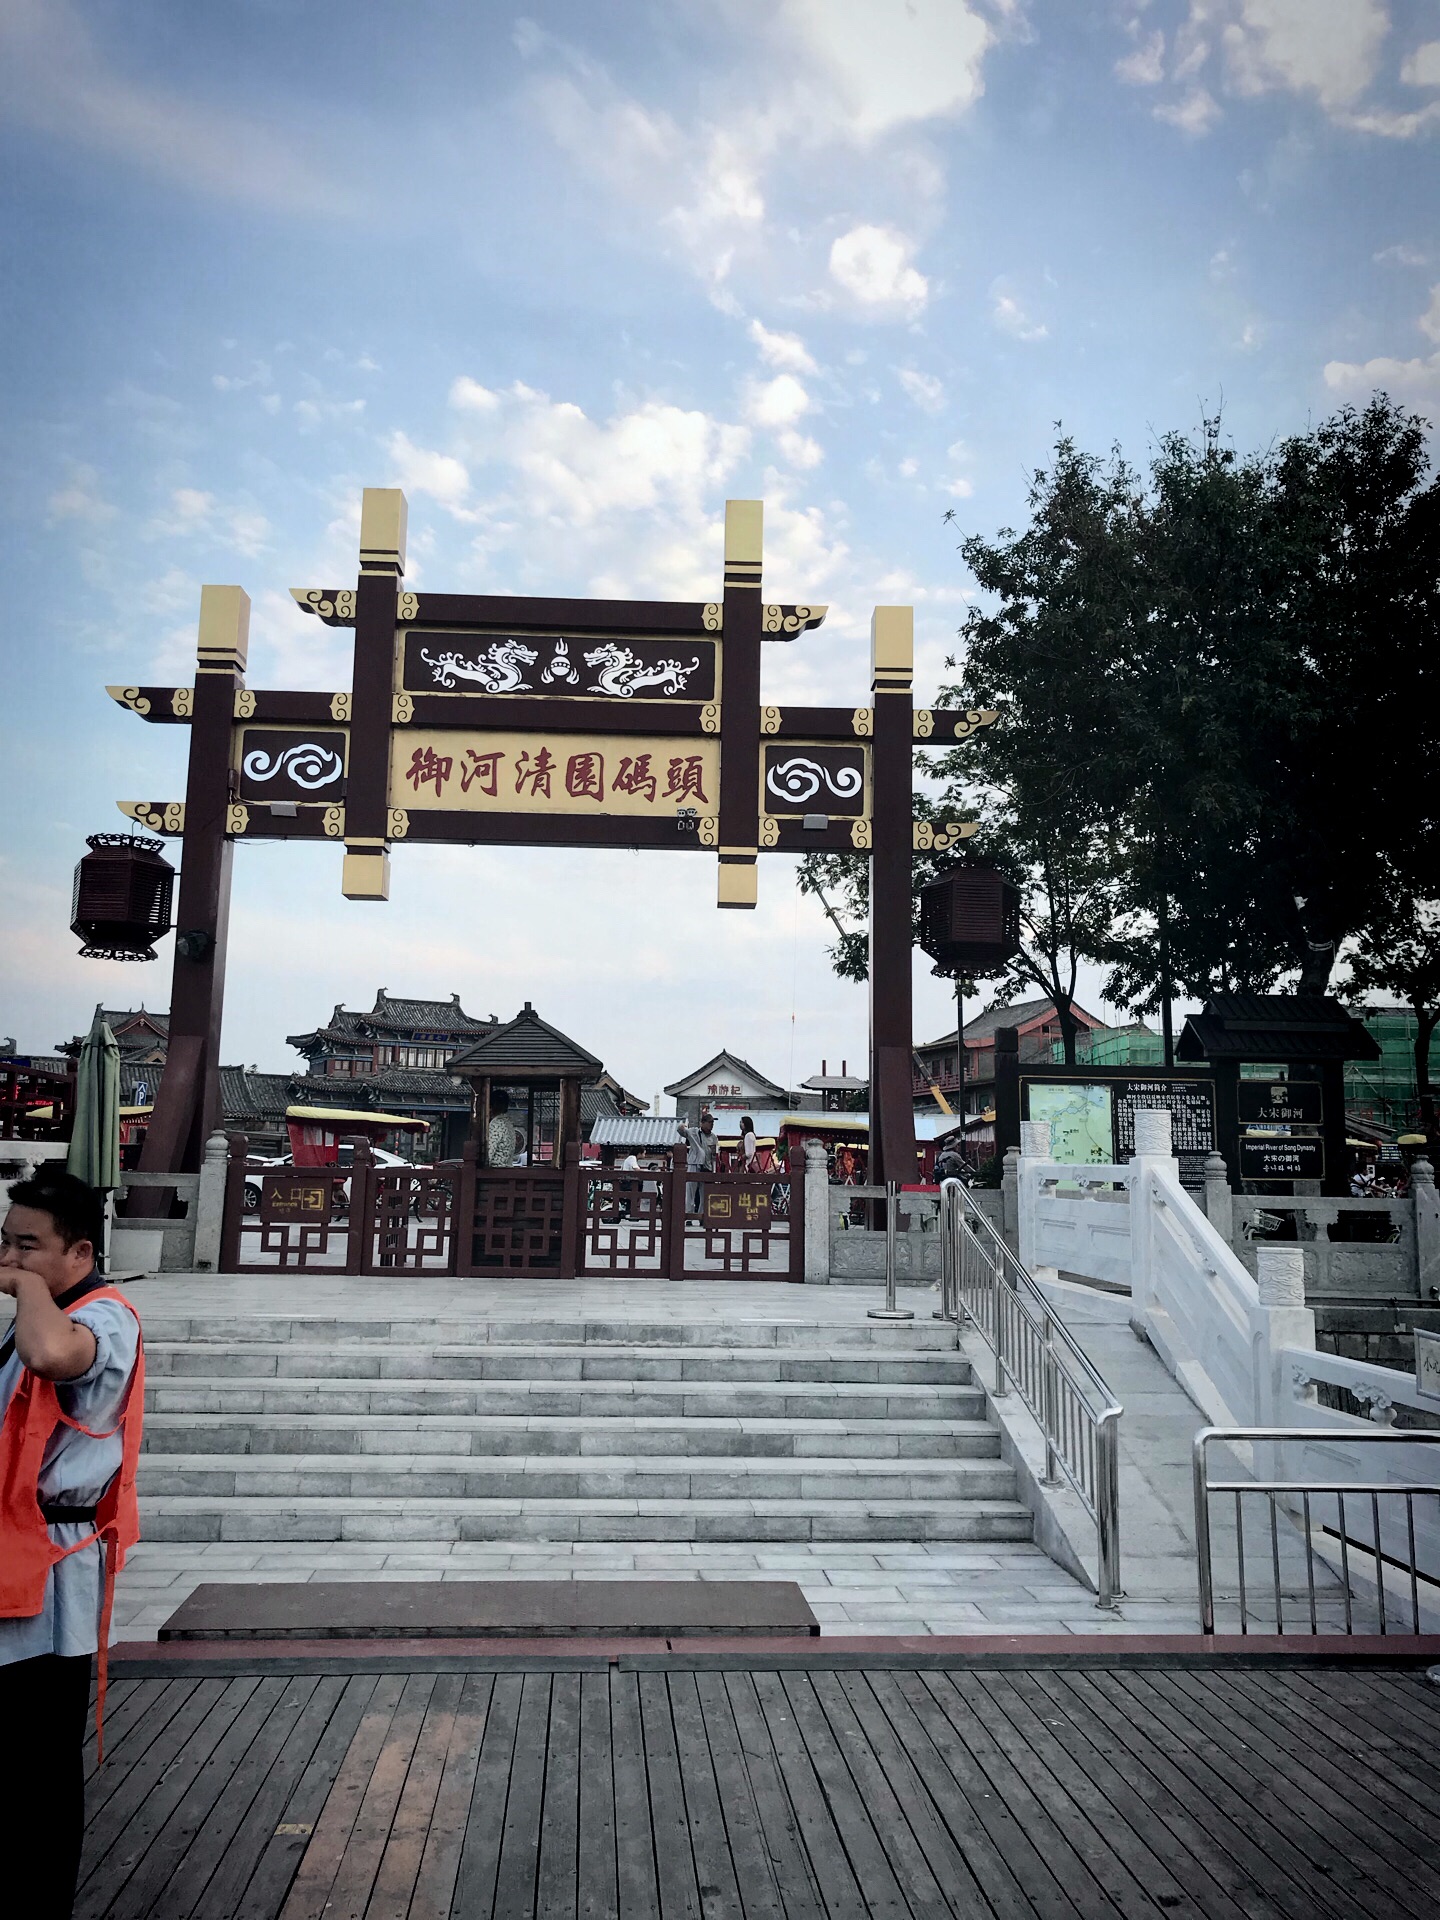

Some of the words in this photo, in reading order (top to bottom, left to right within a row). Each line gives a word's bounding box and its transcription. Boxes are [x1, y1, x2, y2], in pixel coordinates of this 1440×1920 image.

[405, 746, 709, 804] 御河清園碼頭
[707, 1084, 742, 1096] 豫游记
[1127, 1083, 1167, 1091] 大宋御河简介
[1258, 1107, 1303, 1119] 大宋御河
[1284, 1144, 1296, 1152] Song
[1297, 1144, 1315, 1152] Dynasty
[271, 1188, 302, 1201] 入口
[738, 1193, 768, 1207] 出口
